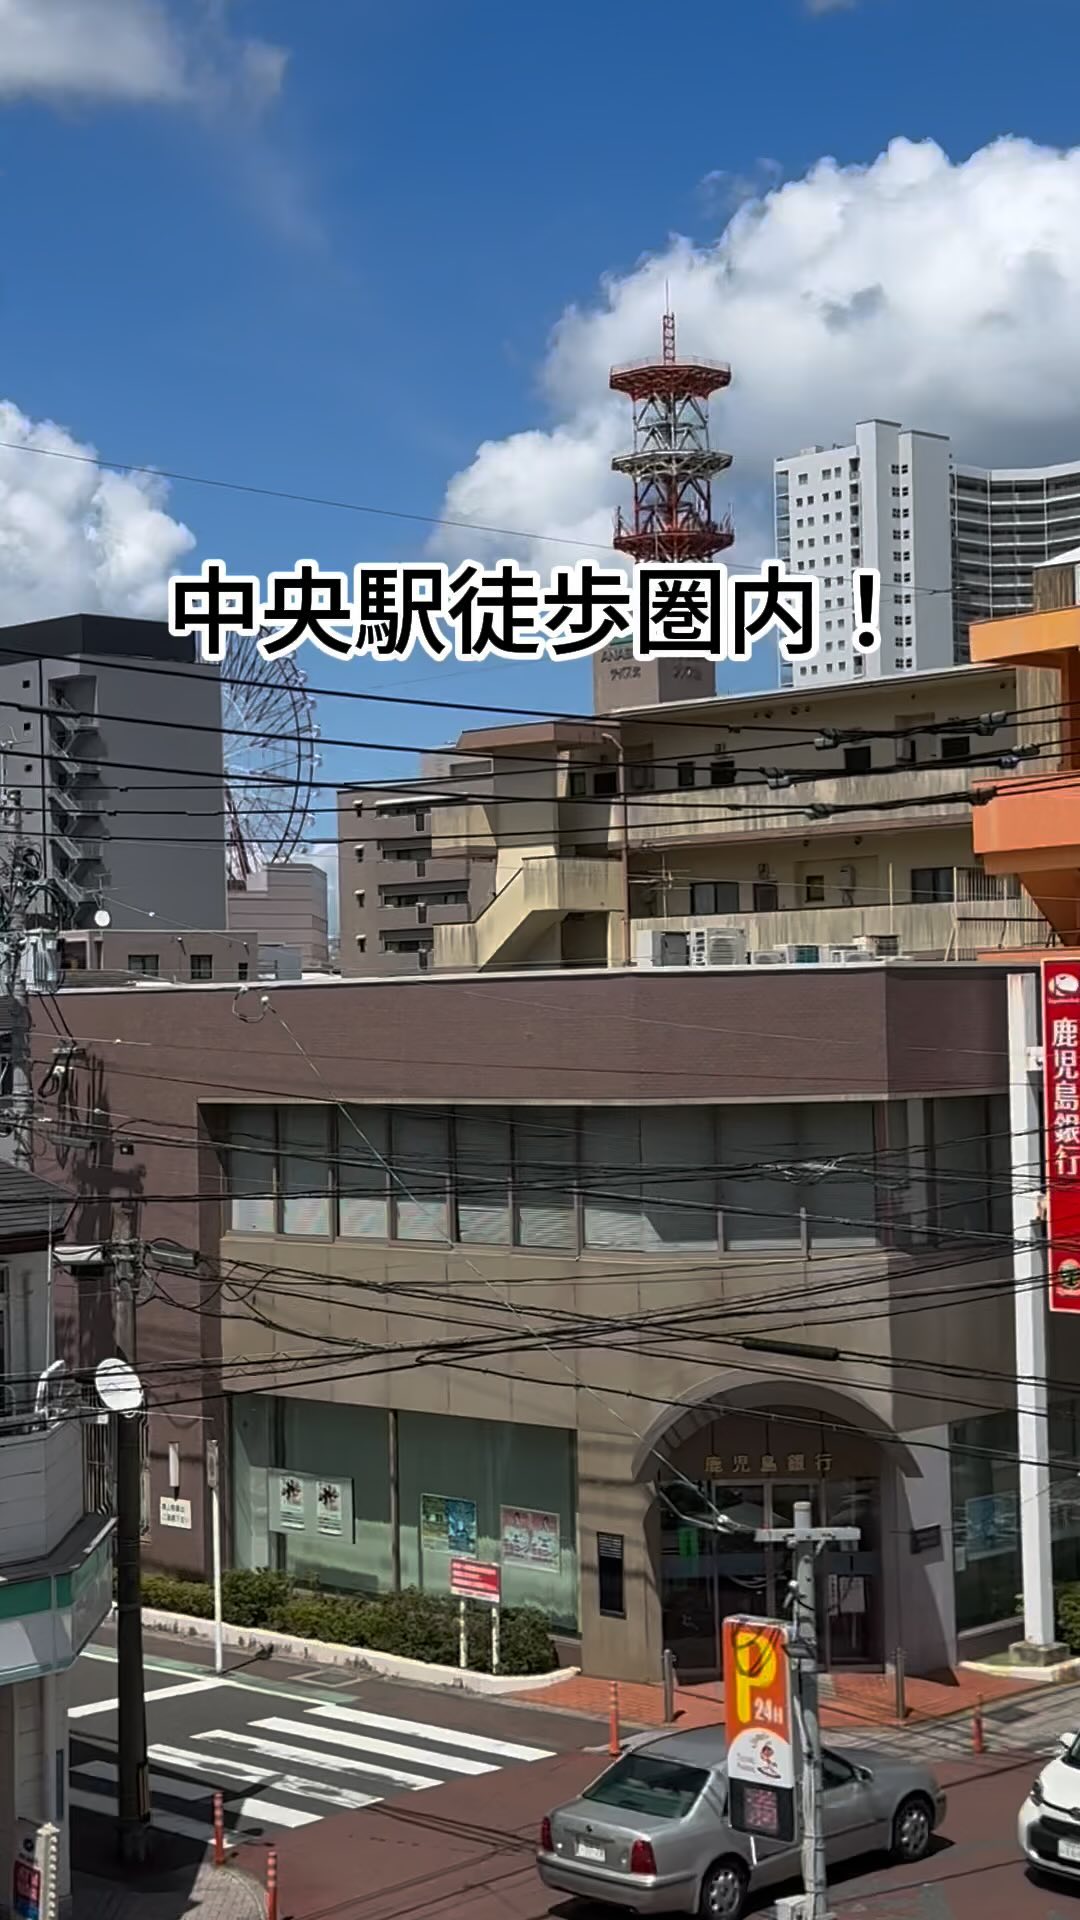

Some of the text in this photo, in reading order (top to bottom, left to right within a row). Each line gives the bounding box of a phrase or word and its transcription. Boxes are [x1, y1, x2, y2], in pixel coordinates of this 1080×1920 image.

[1051, 1016, 1080, 1175] 鹿児島銀行
[704, 1453, 833, 1473] 鹿児島銀行
[735, 1631, 777, 1724] P
[753, 1697, 783, 1724] 24H
